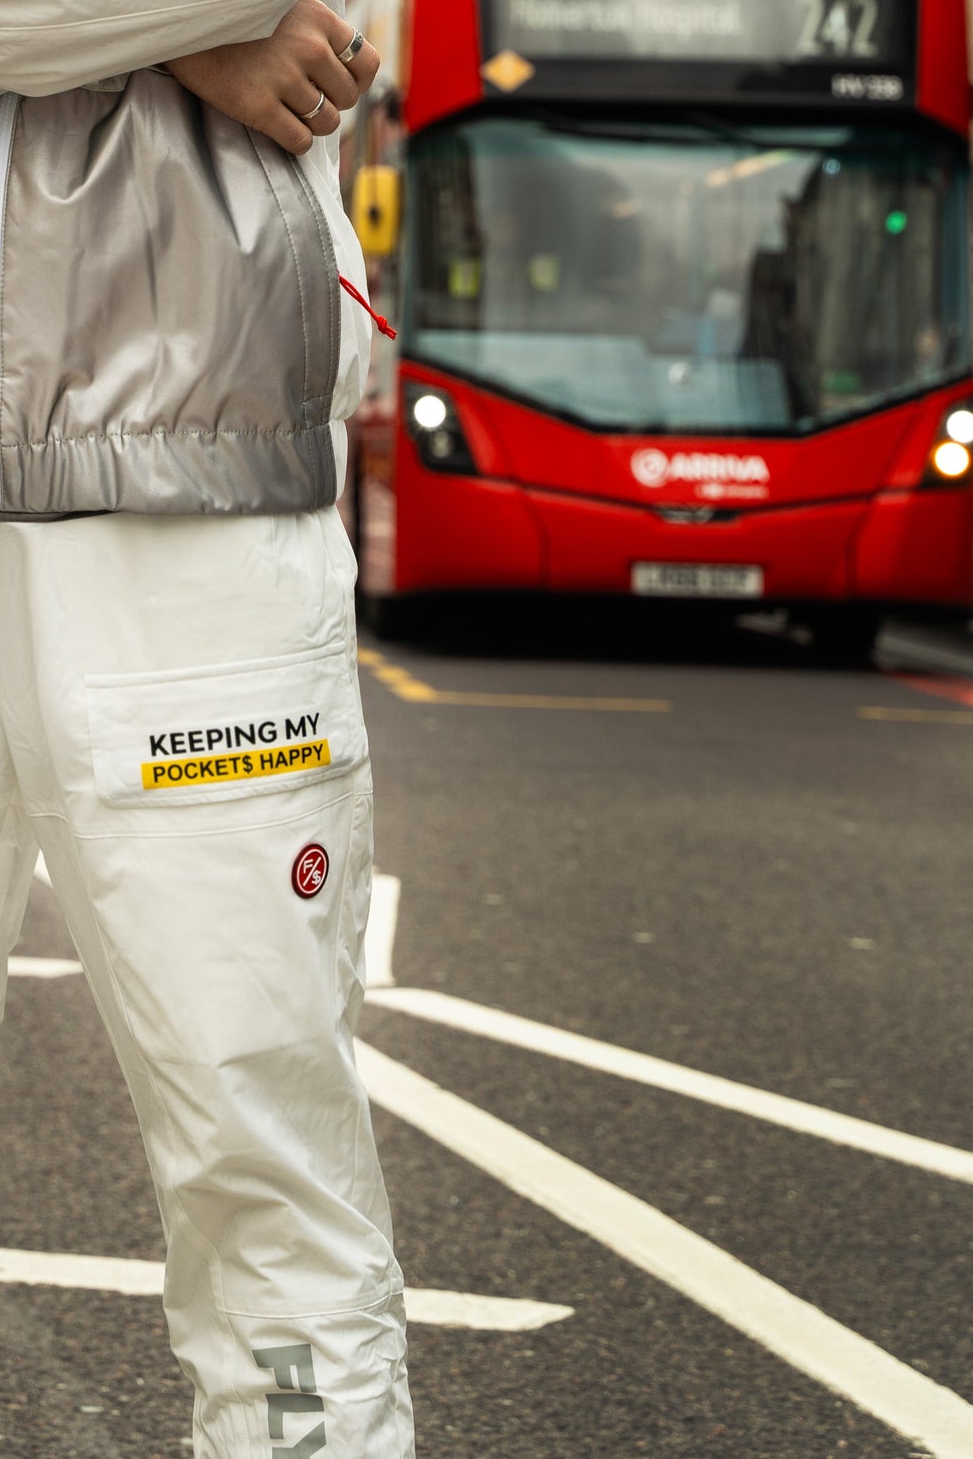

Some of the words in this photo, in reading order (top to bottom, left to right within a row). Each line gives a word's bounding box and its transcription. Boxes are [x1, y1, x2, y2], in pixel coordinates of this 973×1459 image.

[149, 721, 277, 757] KEEPING
[285, 712, 320, 740] MY
[153, 754, 254, 783] POCKET$
[260, 743, 324, 770] HAPPY
